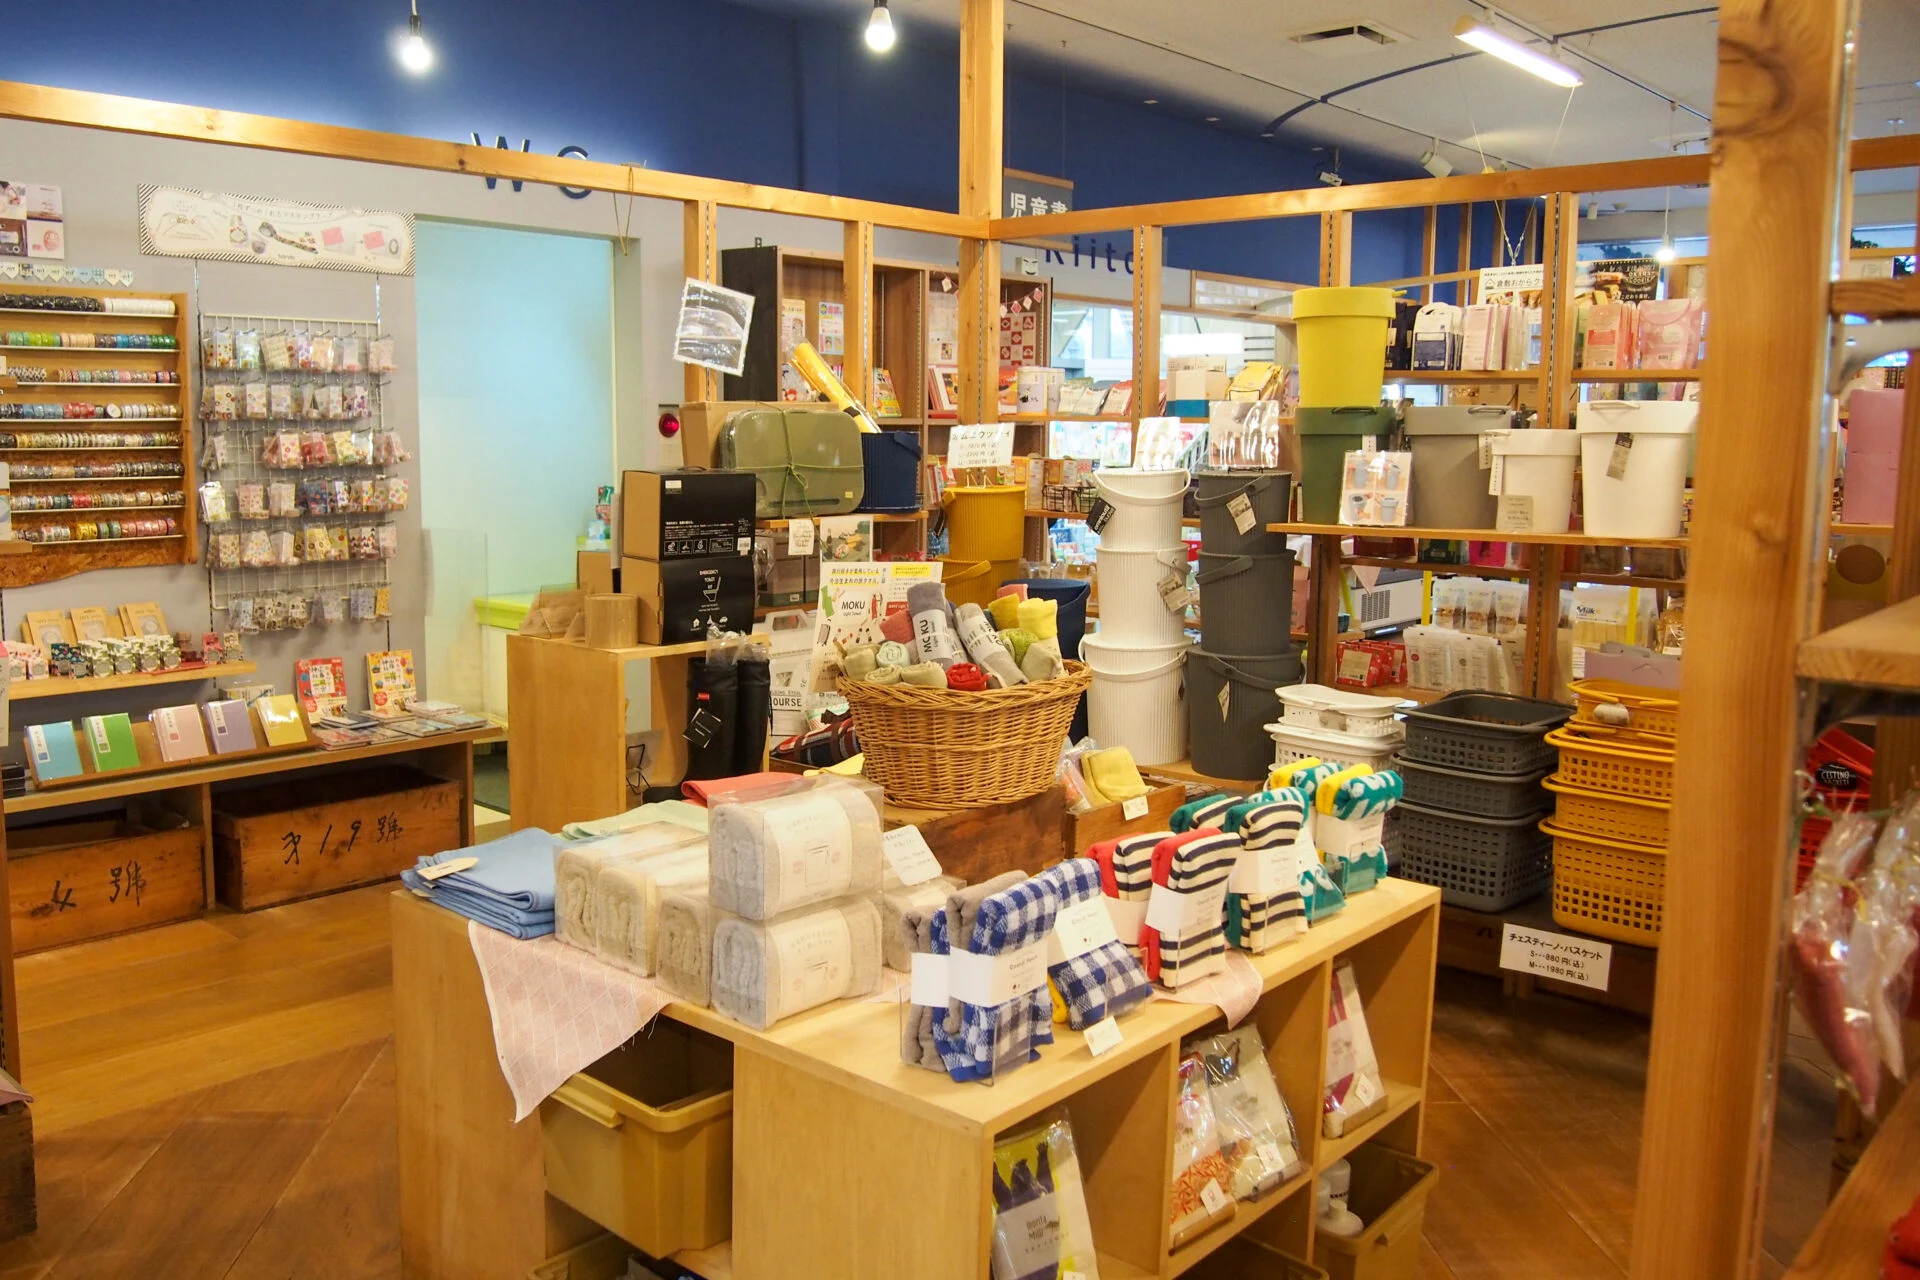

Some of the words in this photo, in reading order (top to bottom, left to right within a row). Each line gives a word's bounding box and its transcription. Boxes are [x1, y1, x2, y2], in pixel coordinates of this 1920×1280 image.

[1496, 278, 1542, 288] 倉敷おからク
[841, 600, 866, 610] MOKU
[772, 698, 802, 707] OURSE
